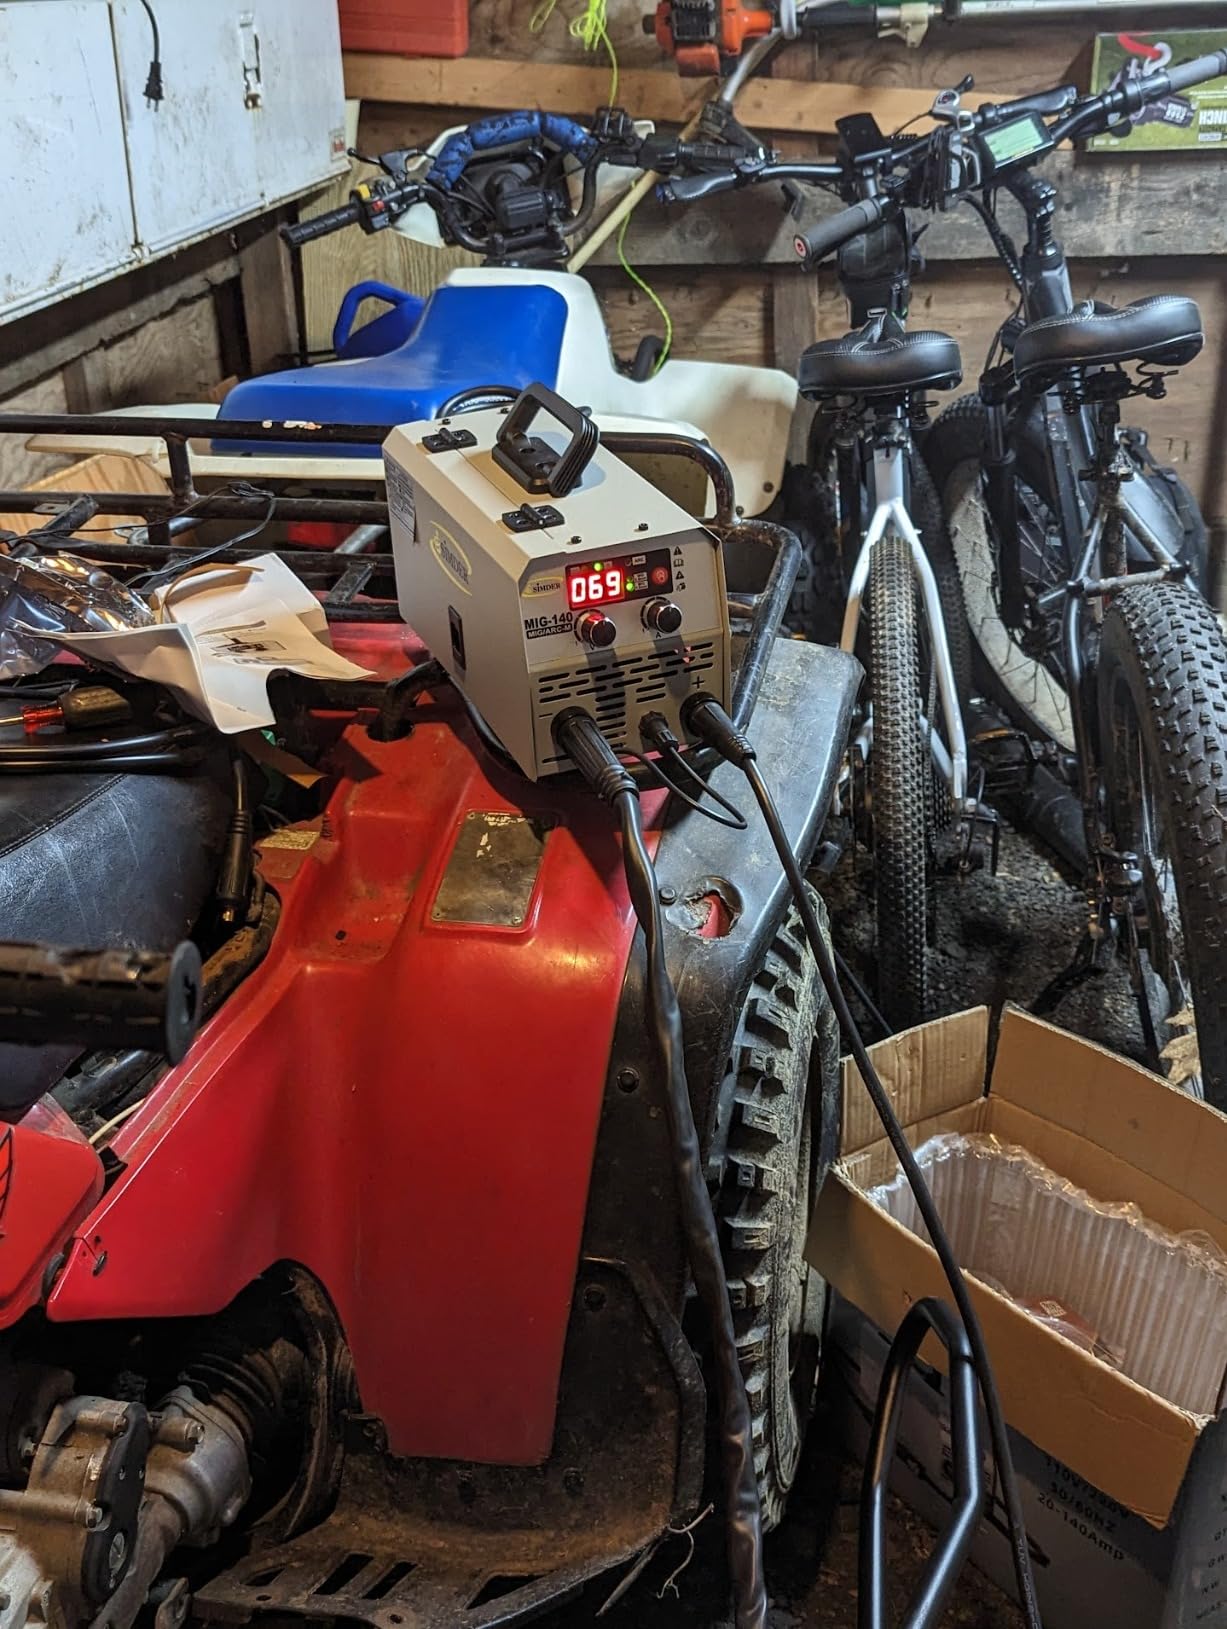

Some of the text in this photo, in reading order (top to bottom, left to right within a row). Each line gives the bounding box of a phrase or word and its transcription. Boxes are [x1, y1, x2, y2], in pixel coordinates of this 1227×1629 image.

[571, 571, 621, 603] 069
[524, 612, 573, 630] MIG-140
[1038, 1492, 1125, 1561] 20-140Amp
